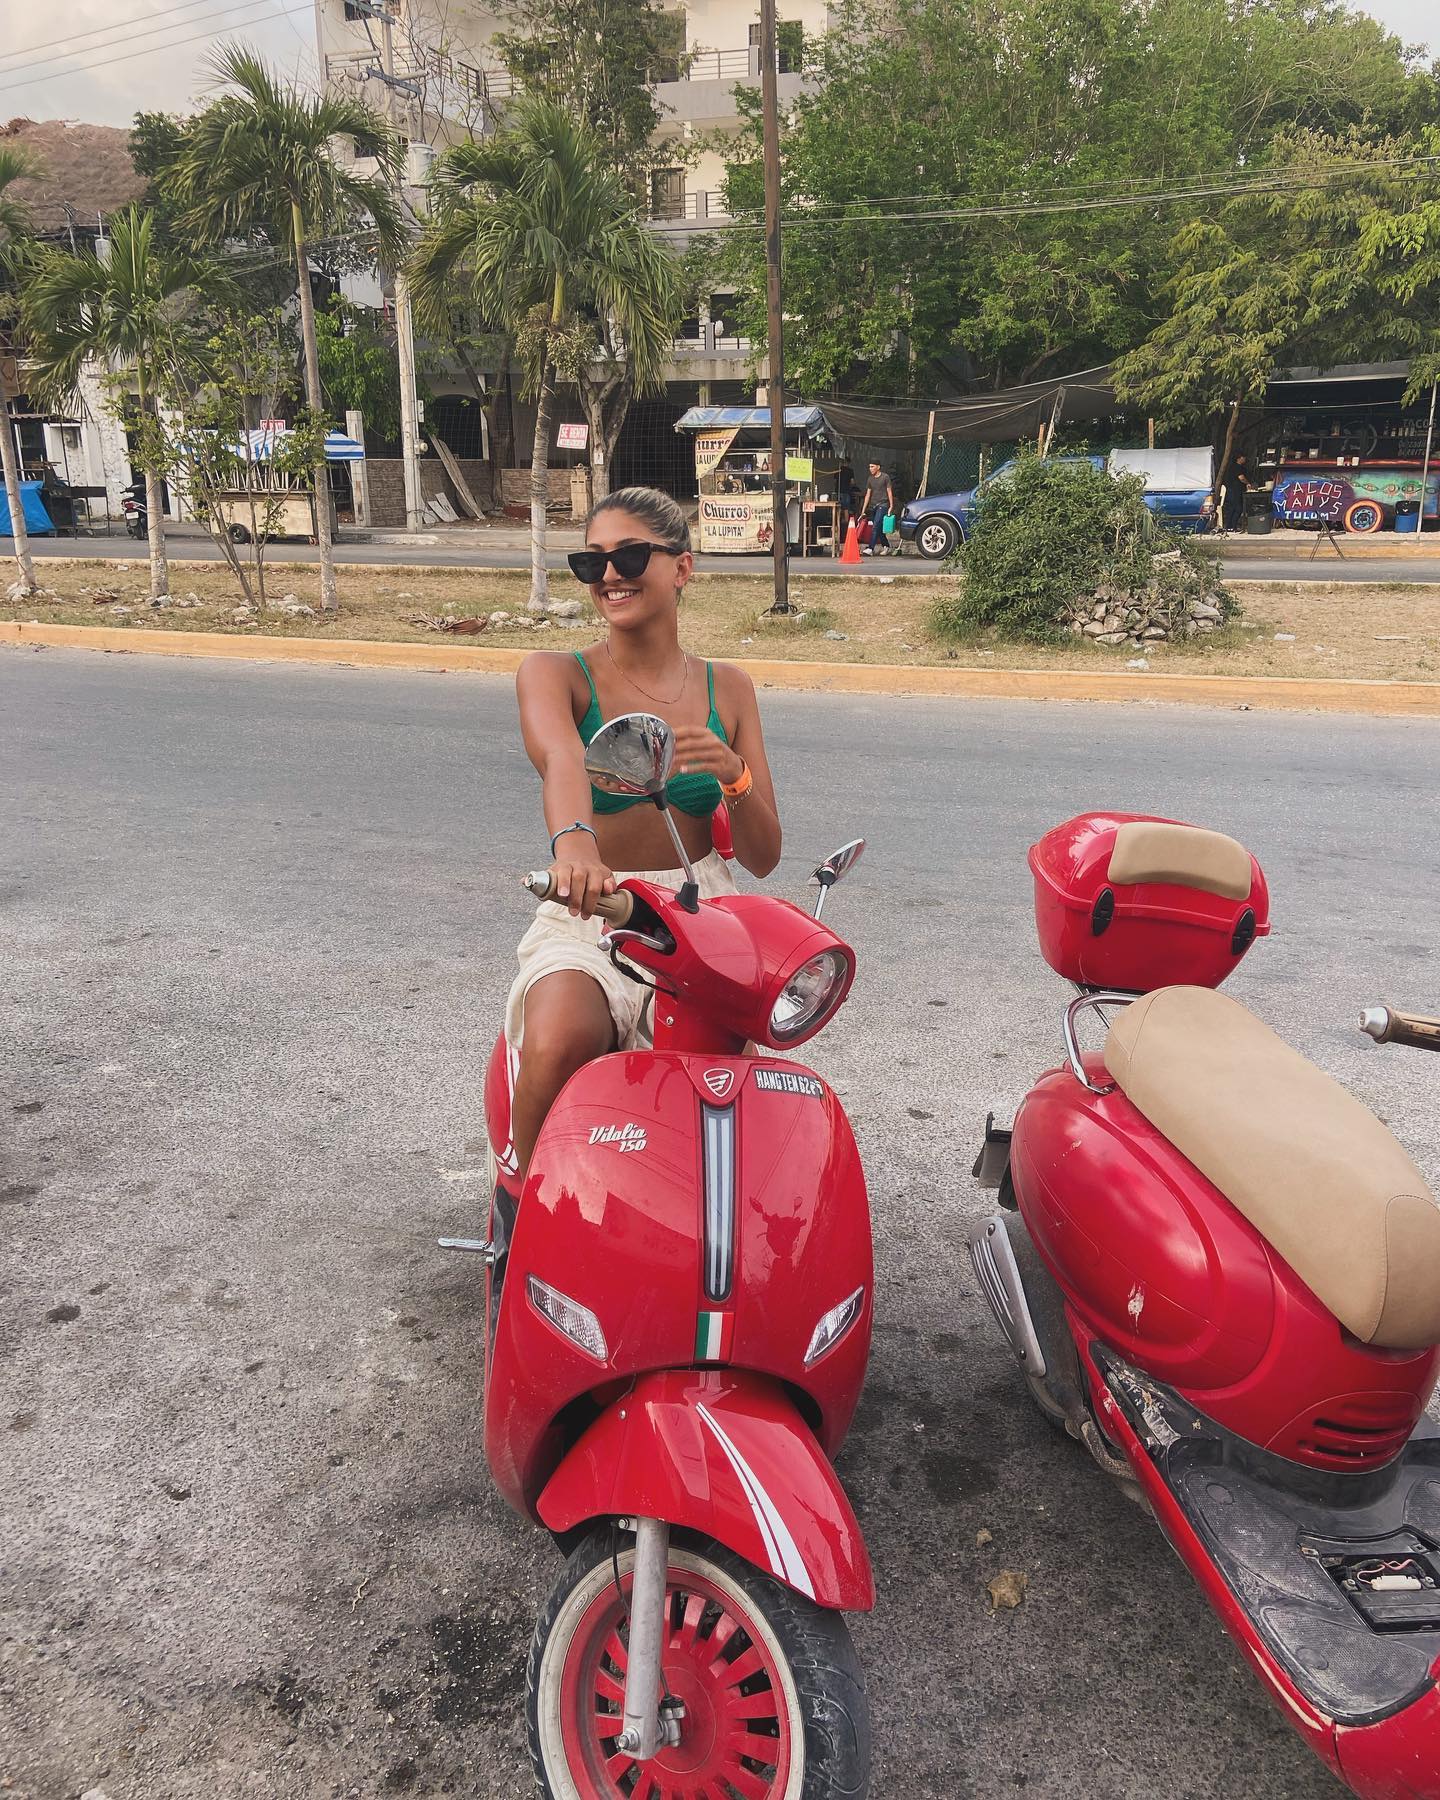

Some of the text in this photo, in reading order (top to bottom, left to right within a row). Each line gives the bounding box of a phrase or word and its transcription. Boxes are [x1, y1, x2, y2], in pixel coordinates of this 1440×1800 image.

[1279, 481, 1343, 499] TACOS
[704, 502, 748, 518] Churros
[1274, 495, 1342, 514] MANYS
[1285, 511, 1329, 520] TULUM
[756, 1070, 783, 1090] HANG
[780, 1073, 799, 1092] TEN
[588, 1123, 647, 1145] Vitalia
[618, 1139, 647, 1153] 150
